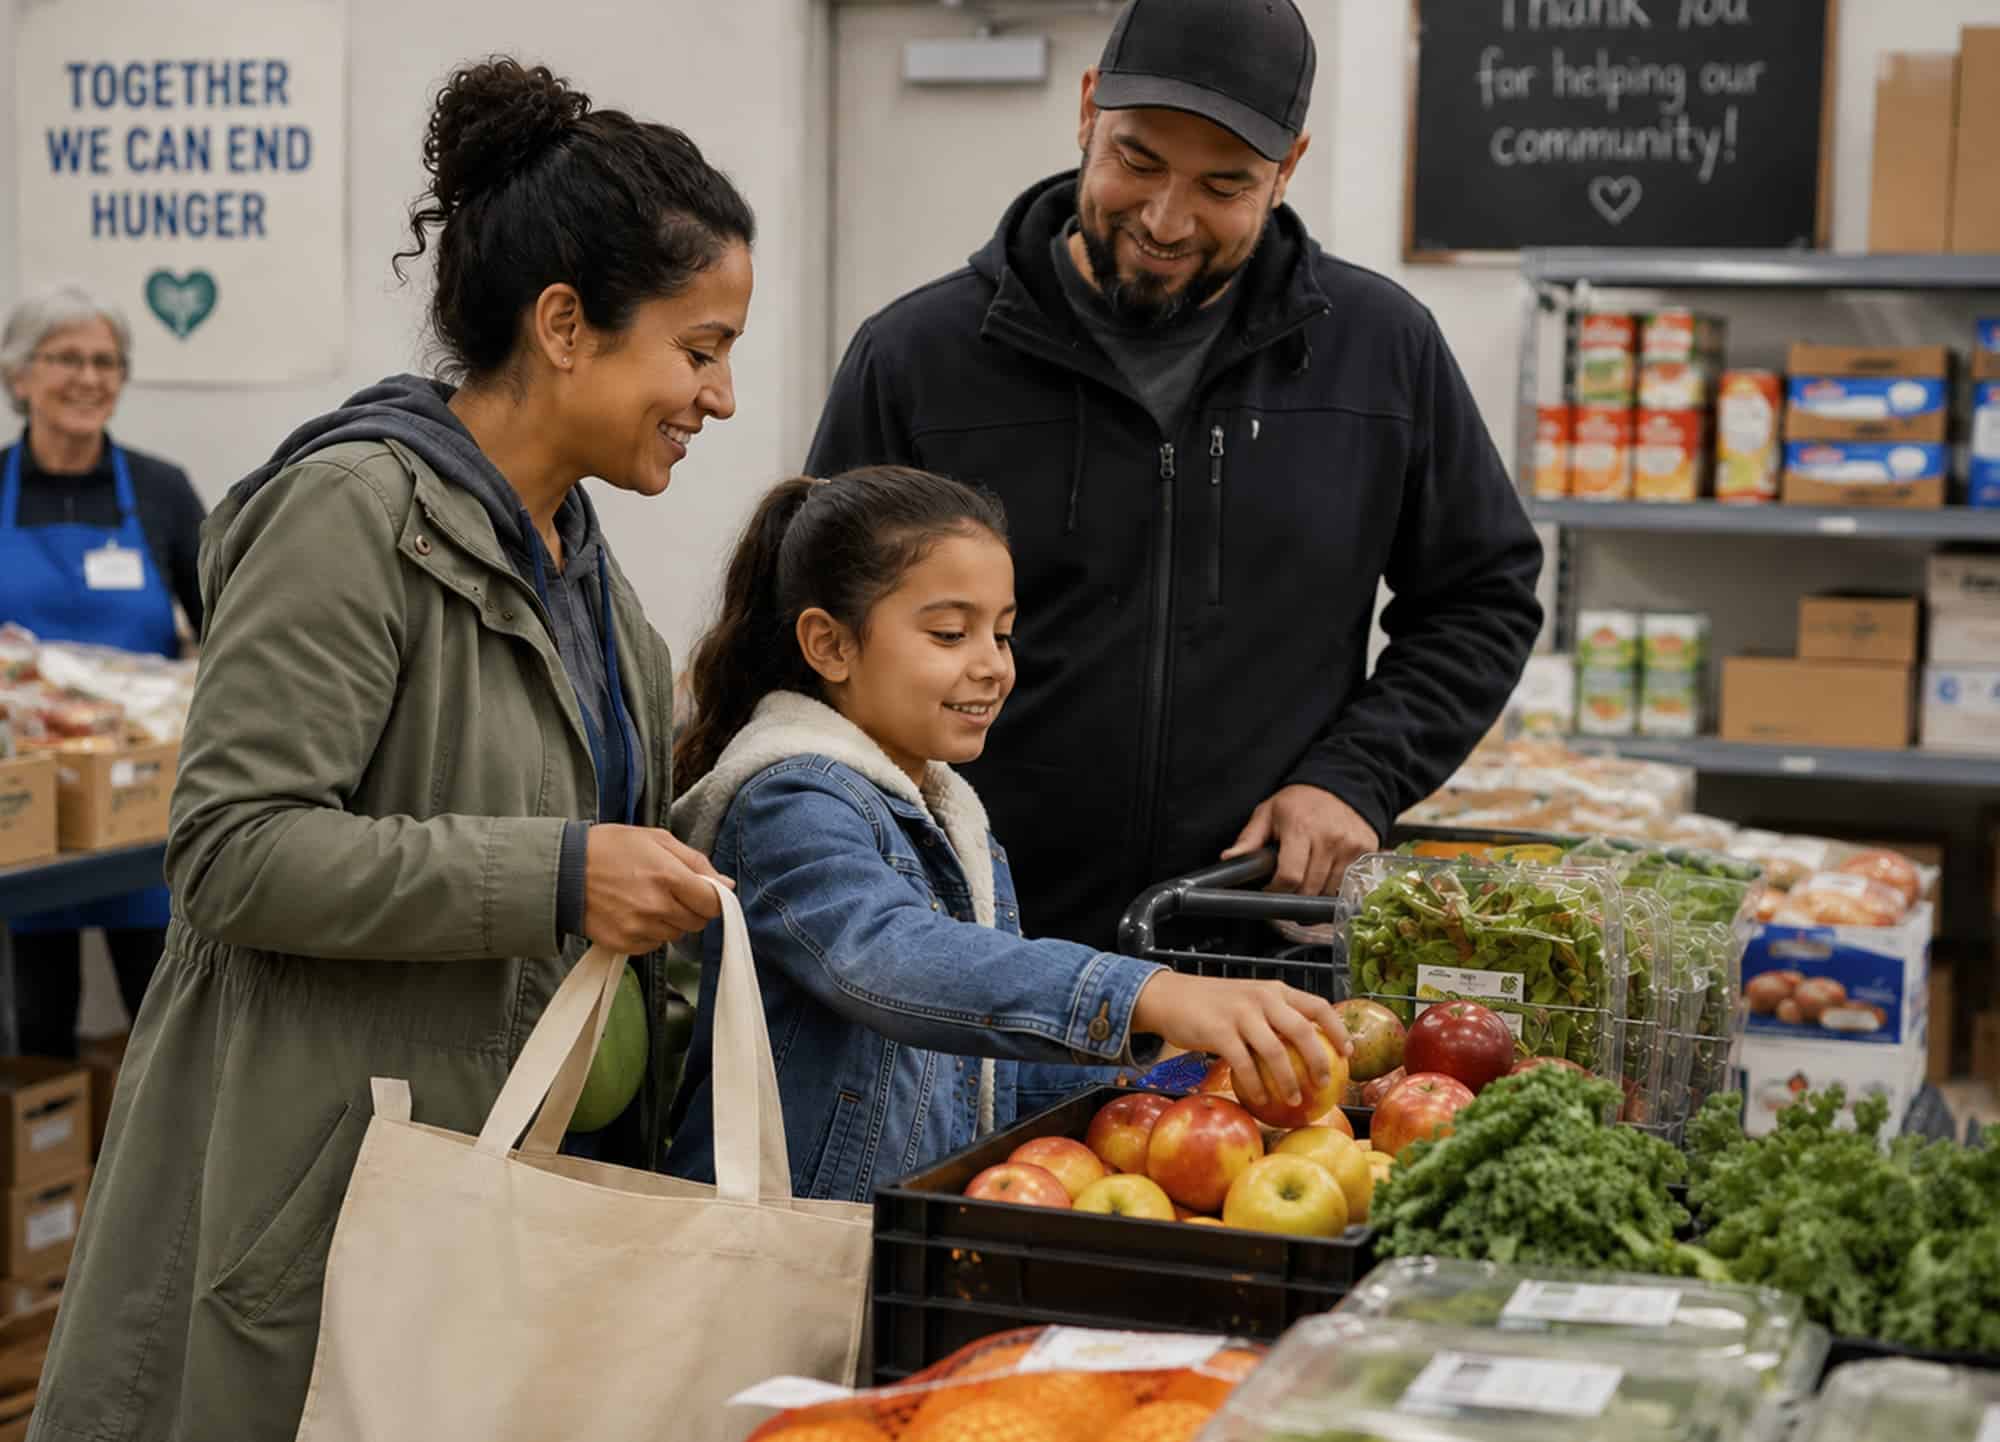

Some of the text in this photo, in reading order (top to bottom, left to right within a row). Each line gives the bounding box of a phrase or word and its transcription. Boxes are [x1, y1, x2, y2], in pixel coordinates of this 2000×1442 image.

[66, 59, 290, 110] TOGETHER
[1475, 44, 1765, 115] for helping our
[46, 125, 312, 175] WE CAN END
[1489, 104, 1738, 184] community!
[90, 190, 267, 239] HUNGER
